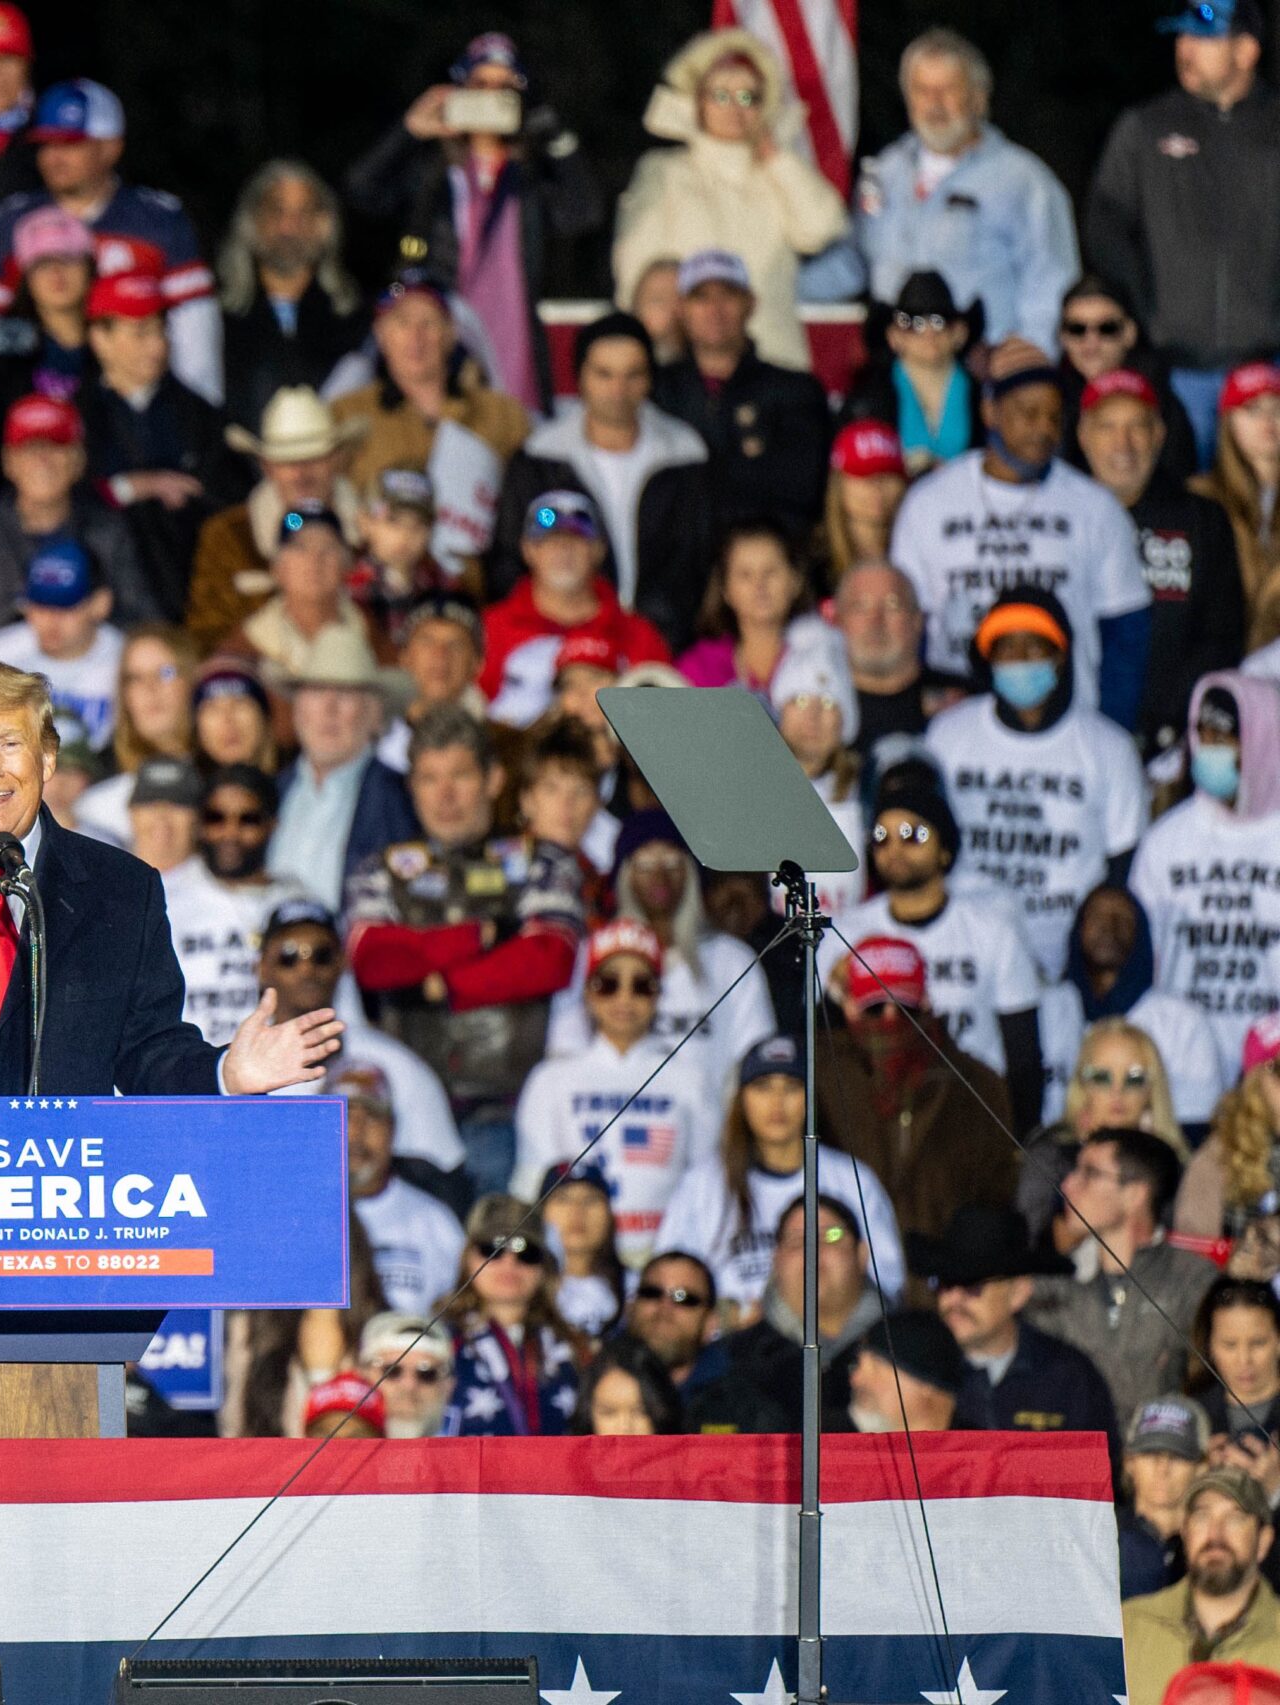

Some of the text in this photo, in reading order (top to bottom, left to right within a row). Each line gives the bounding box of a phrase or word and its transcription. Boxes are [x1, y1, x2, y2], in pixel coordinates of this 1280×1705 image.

[20, 1227, 90, 1241] DONALD
[95, 1227, 109, 1240] J.
[114, 1226, 170, 1240] TRUMP
[64, 1255, 91, 1270] TO
[97, 1254, 160, 1270] 88022
